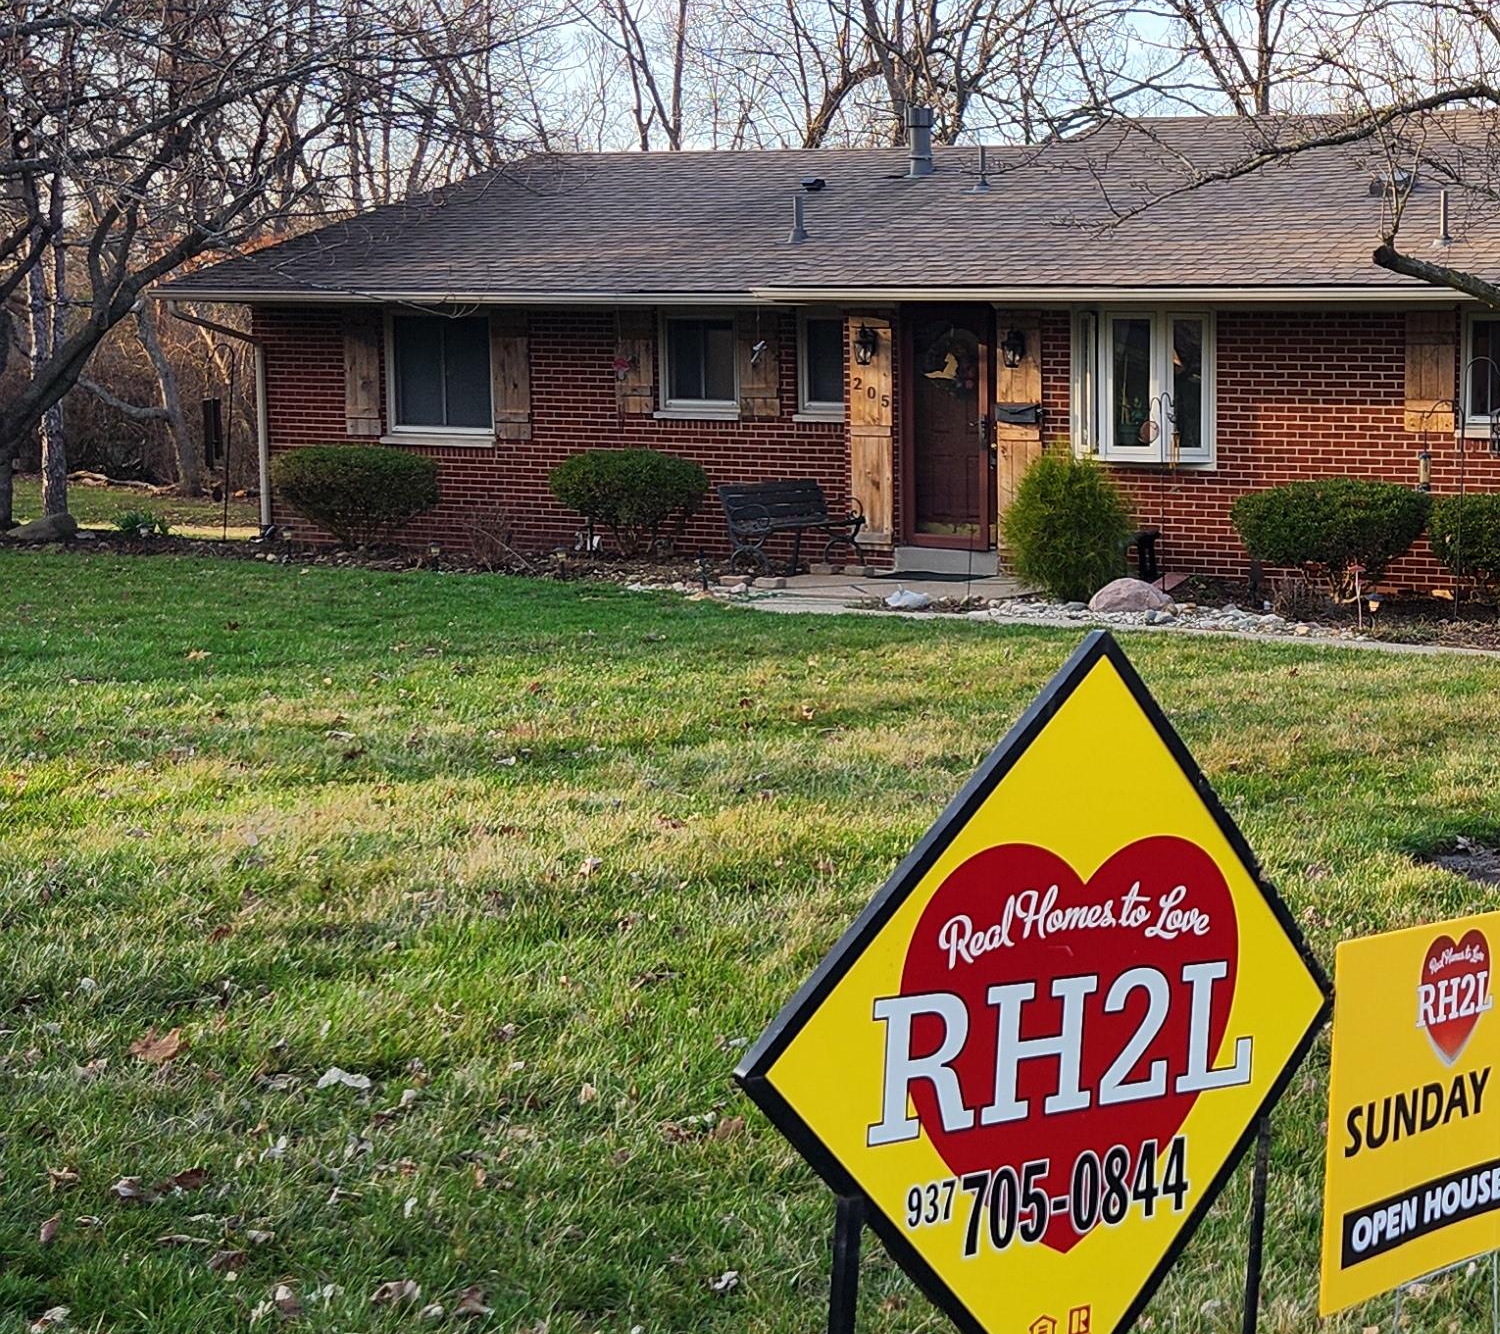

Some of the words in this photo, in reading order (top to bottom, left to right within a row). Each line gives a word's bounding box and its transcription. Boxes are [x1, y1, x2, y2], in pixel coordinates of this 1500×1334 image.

[853, 377, 889, 408] 205
[938, 894, 1015, 970] Real
[1015, 884, 1116, 939] Homes
[1118, 881, 1151, 927] to
[1144, 885, 1210, 940] Love
[1415, 970, 1493, 1028] RH2L
[866, 961, 1253, 1148] RH2L
[1344, 1067, 1491, 1158] SUNDAY
[907, 1176, 957, 1229] 937
[962, 1135, 1189, 1258] 705-0844
[1350, 1195, 1417, 1253] OPEN
